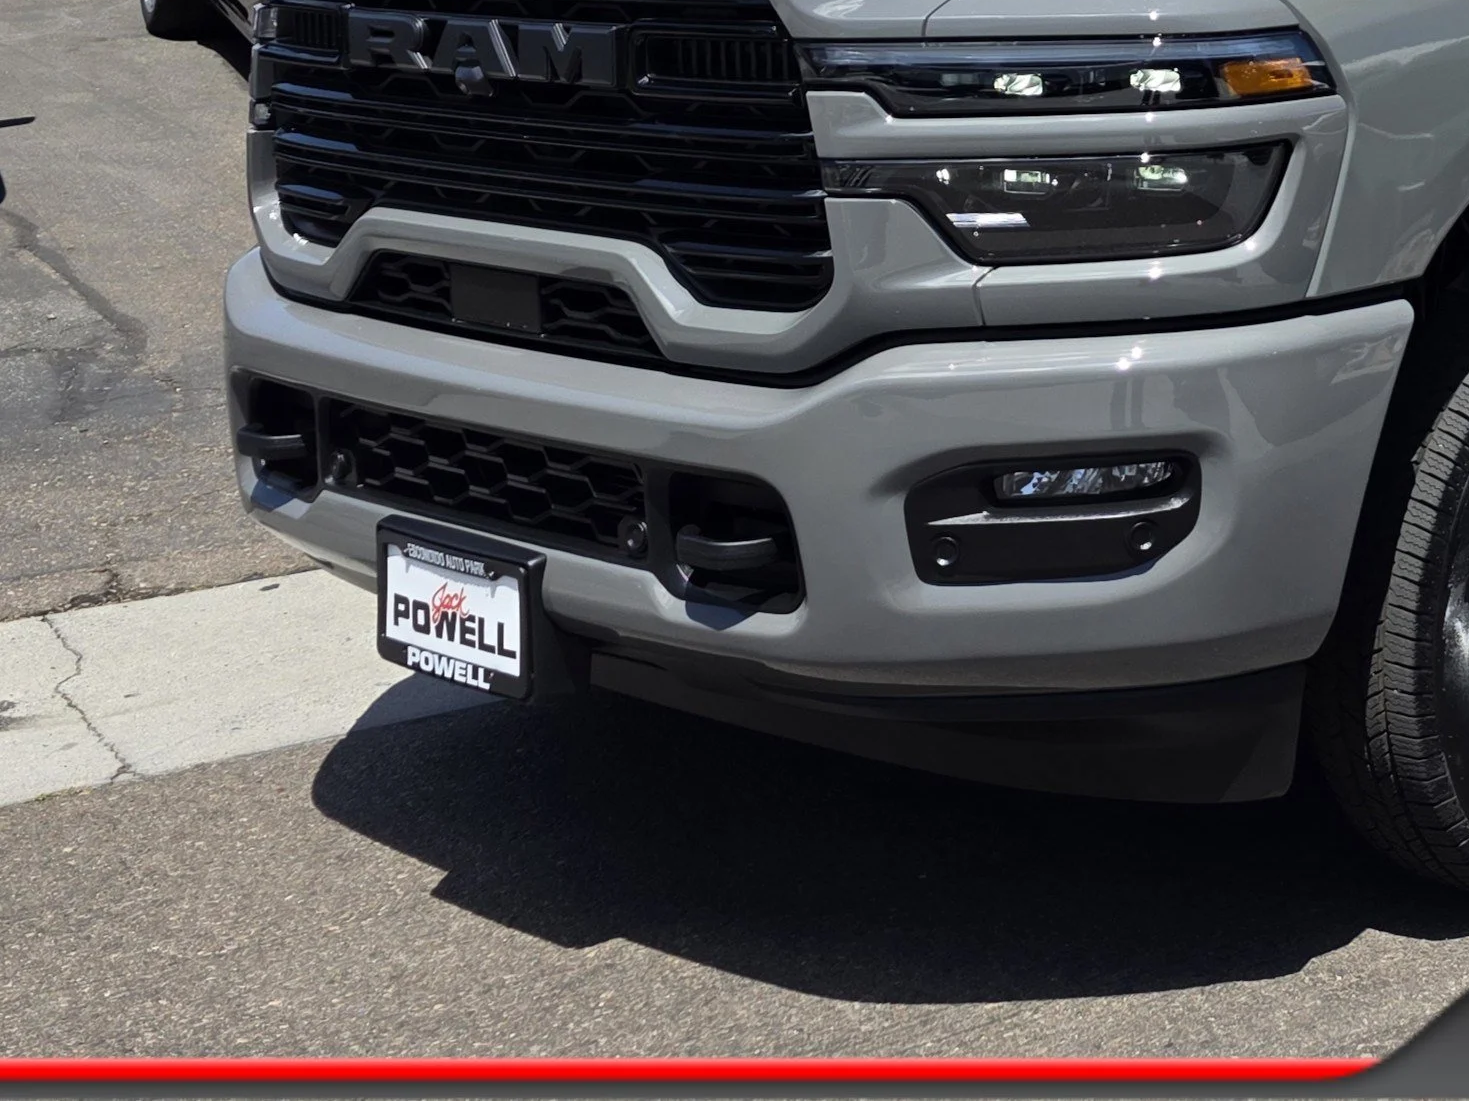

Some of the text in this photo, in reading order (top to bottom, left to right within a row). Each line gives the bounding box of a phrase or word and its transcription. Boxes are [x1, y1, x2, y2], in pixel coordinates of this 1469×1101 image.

[346, 7, 618, 89] RAM
[406, 542, 485, 577] ESCONDIDO AUTO PARK
[393, 593, 517, 660] POWELL
[431, 582, 470, 626] Jack
[406, 645, 491, 690] POWELL
